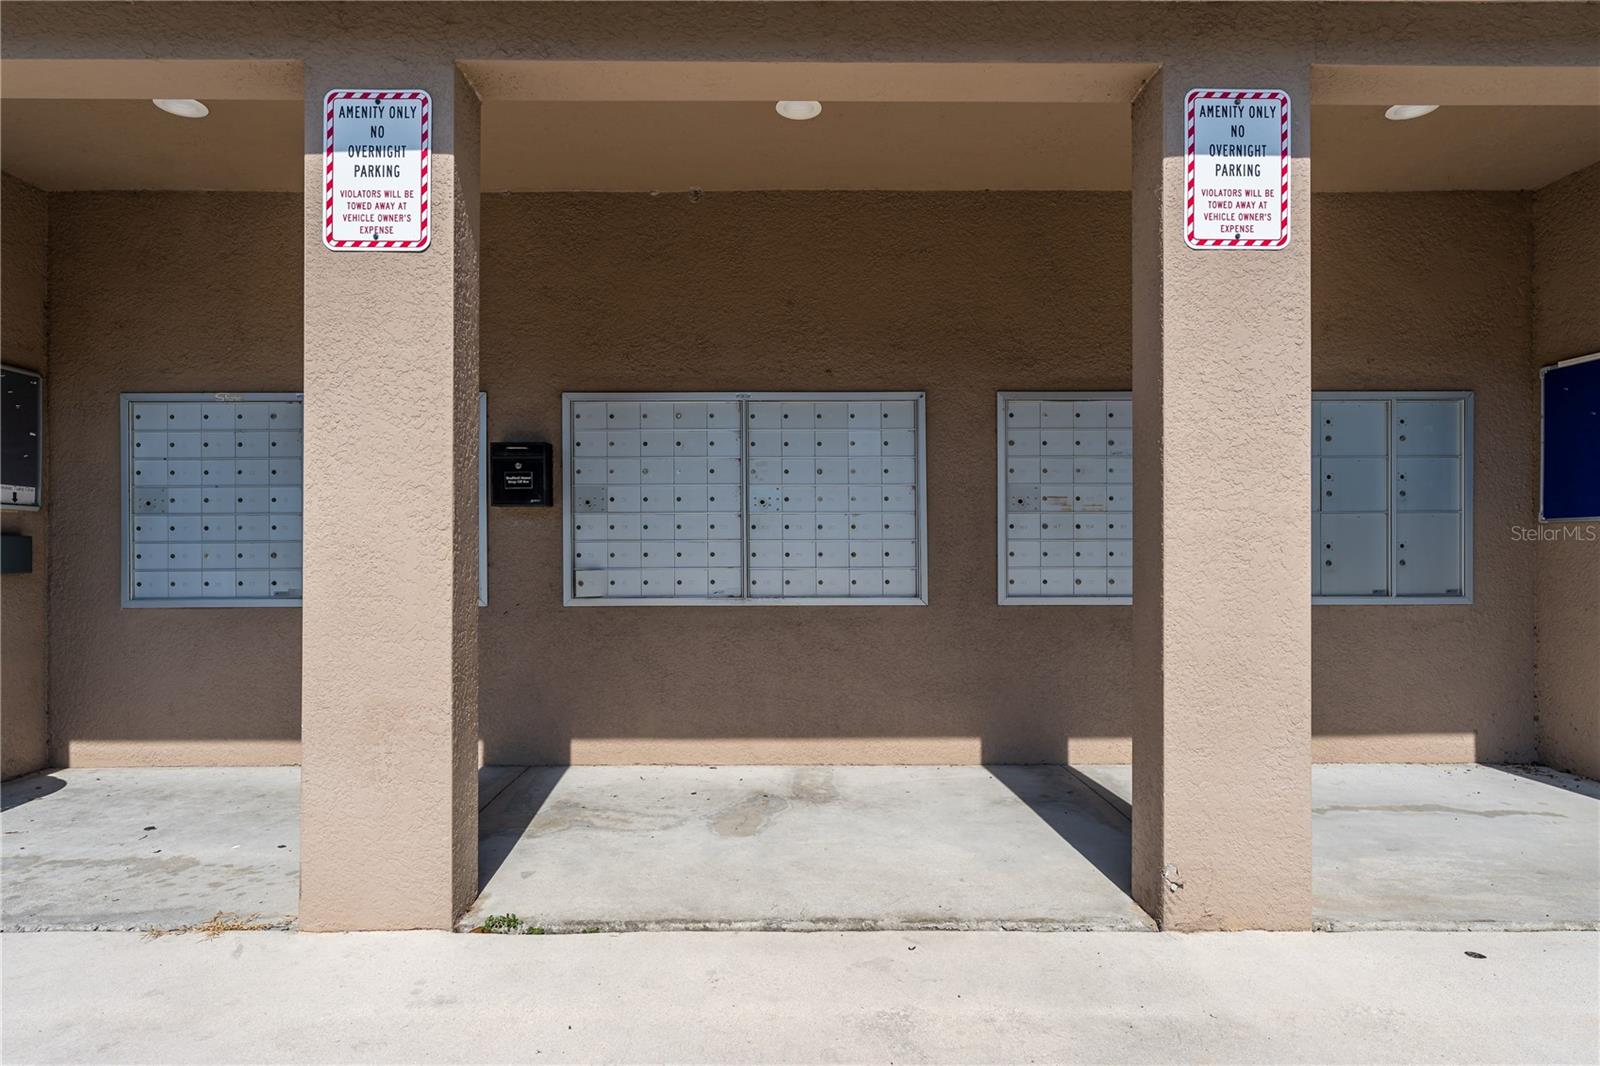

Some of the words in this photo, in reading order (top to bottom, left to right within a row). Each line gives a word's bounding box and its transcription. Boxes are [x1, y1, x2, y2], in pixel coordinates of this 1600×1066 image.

[339, 106, 384, 119] AMENITY
[389, 106, 417, 119] ONLY
[1200, 105, 1244, 118] AMENITY
[1249, 105, 1276, 118] ONLY
[370, 126, 385, 138] NO
[1231, 125, 1245, 137] NO
[348, 145, 407, 158] OVERNIGHT
[1209, 144, 1267, 157] OVERNIGHT
[354, 165, 400, 178] PARKING
[1215, 164, 1261, 177] PARKING
[340, 190, 381, 198] VIOLATORS
[384, 190, 401, 198] WILL
[404, 190, 414, 198] BE
[1201, 189, 1242, 197] VIOLATORS
[1245, 189, 1262, 197] WILL
[1265, 189, 1275, 197] BE
[347, 202, 372, 210] TOWED
[375, 202, 396, 210] AWAY
[398, 202, 407, 210] AT
[1208, 201, 1233, 209] TOWED
[1236, 201, 1256, 209] AWAY
[1258, 201, 1267, 209] AT
[342, 214, 374, 222] VEHICLE
[377, 214, 412, 222] OWNER'S
[1203, 213, 1235, 221] VEHICLE
[1238, 213, 1272, 221] OWNER'S
[359, 226, 394, 234] EXPENSE
[1220, 225, 1254, 233] EXPENSE
